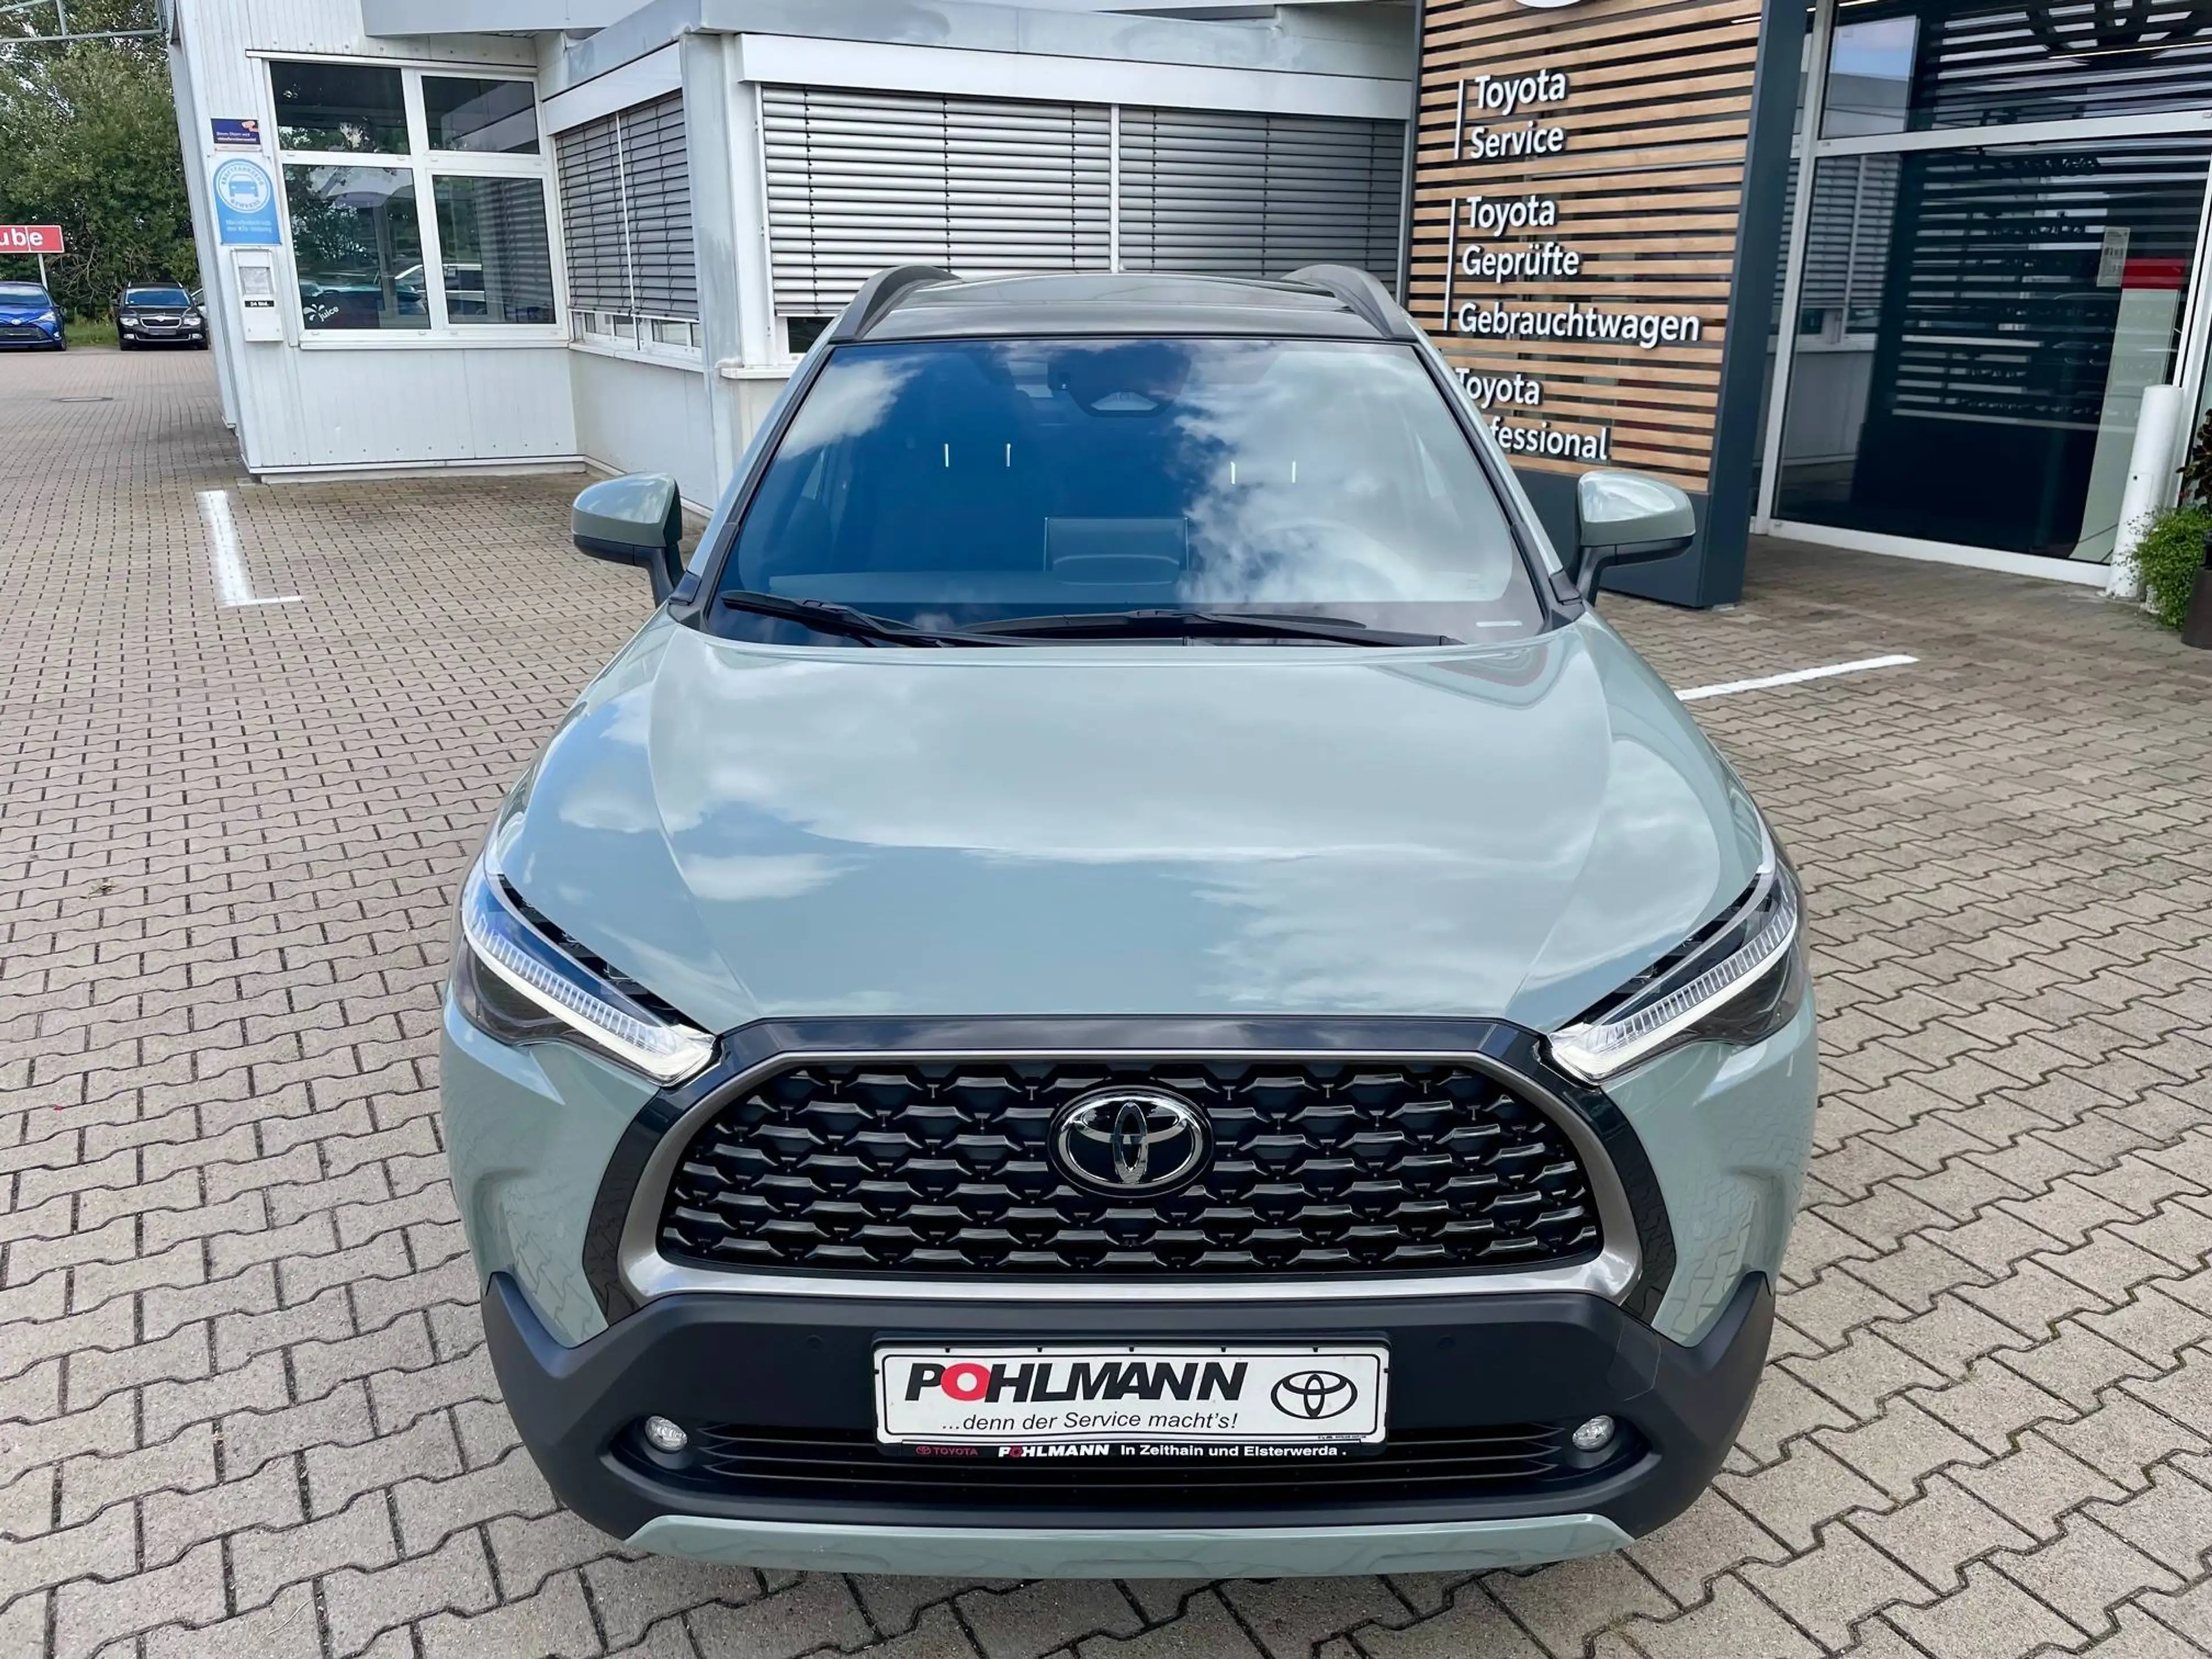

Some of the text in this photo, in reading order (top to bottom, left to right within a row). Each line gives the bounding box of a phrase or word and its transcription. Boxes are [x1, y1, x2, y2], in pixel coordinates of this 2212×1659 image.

[1475, 69, 1566, 116] Toyota
[1471, 122, 1564, 159] Service
[1465, 195, 1556, 236] Toyota
[1462, 242, 1580, 282] Geprüfte
[318, 306, 339, 322] juice
[1458, 302, 1699, 349] Gebrauchtwagen
[1455, 368, 1540, 409] Toyota
[1490, 415, 1608, 460] fessional
[905, 1362, 1248, 1403] POHLMANN
[1022, 1414, 1058, 1430] der
[1064, 1411, 1141, 1428] Service
[1148, 1412, 1238, 1429] macht's!
[998, 1445, 1109, 1457] POHLMANN
[1140, 1445, 1204, 1456] Zeithain
[1209, 1445, 1238, 1456] und
[1244, 1445, 1338, 1456] Elsterwerda
